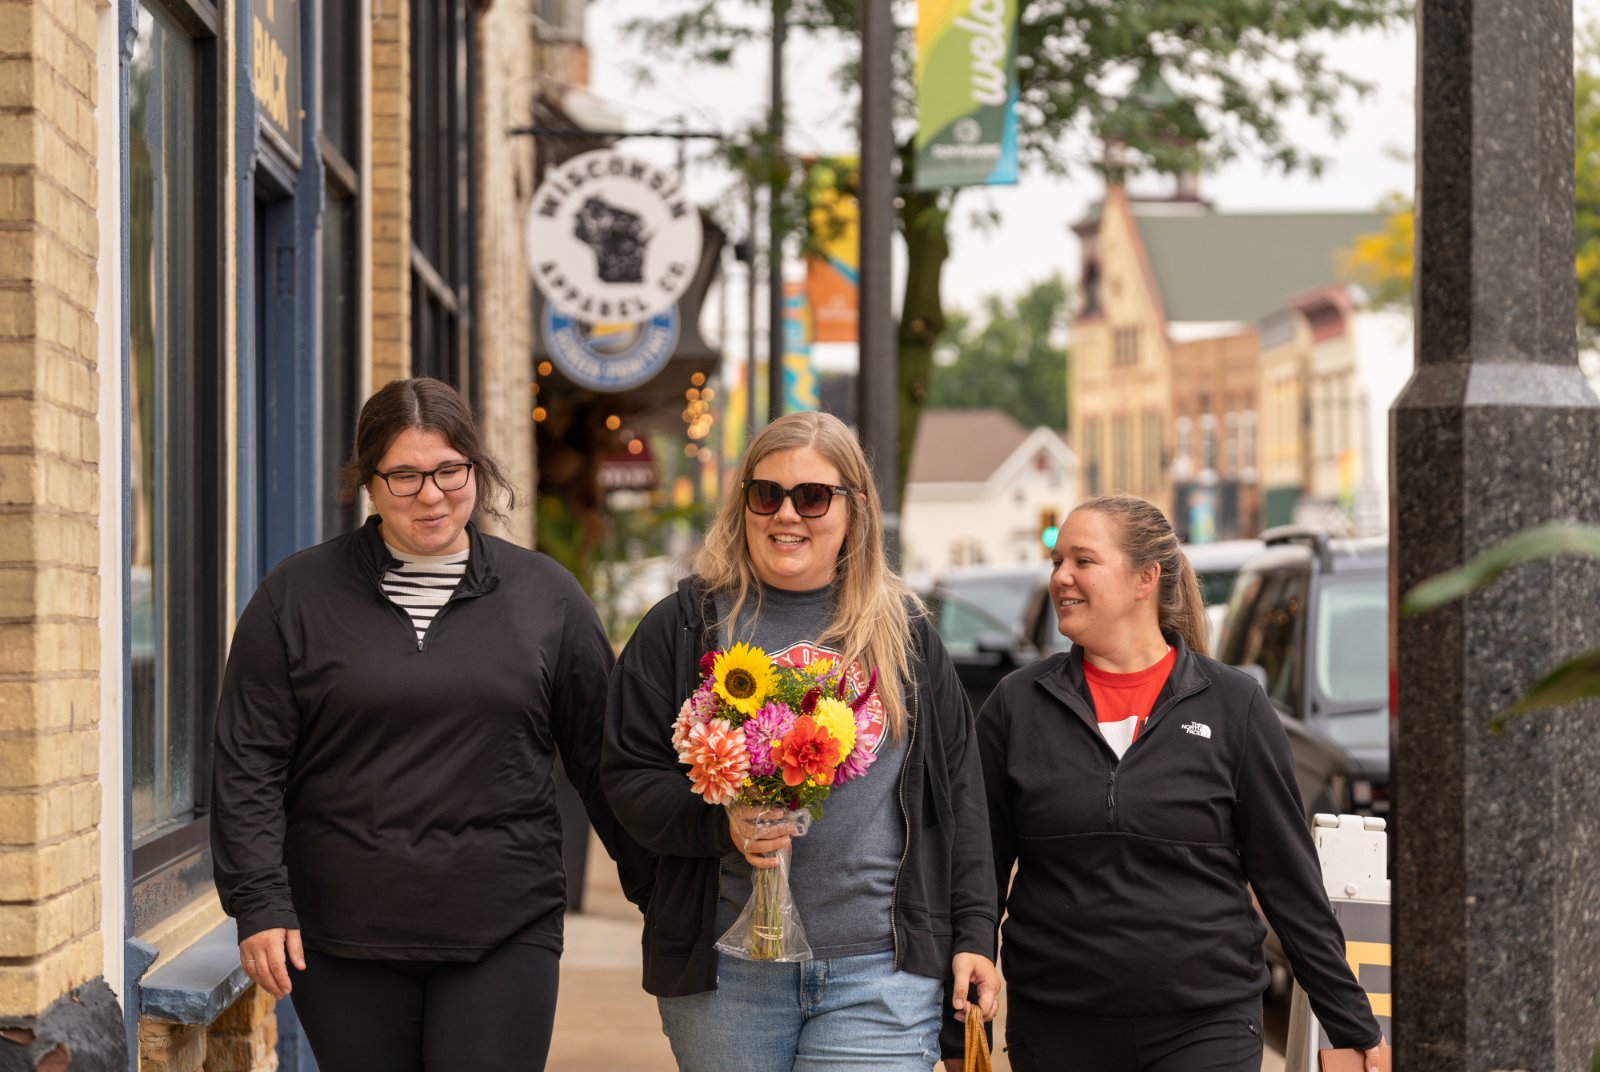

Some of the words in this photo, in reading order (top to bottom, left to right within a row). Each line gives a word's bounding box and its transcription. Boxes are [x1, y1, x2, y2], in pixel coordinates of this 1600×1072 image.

[538, 158, 687, 219] WISCONSIN
[540, 261, 648, 317] APPAREL
[1181, 723, 1201, 732] NORTH
[1186, 728, 1201, 736] FACE
